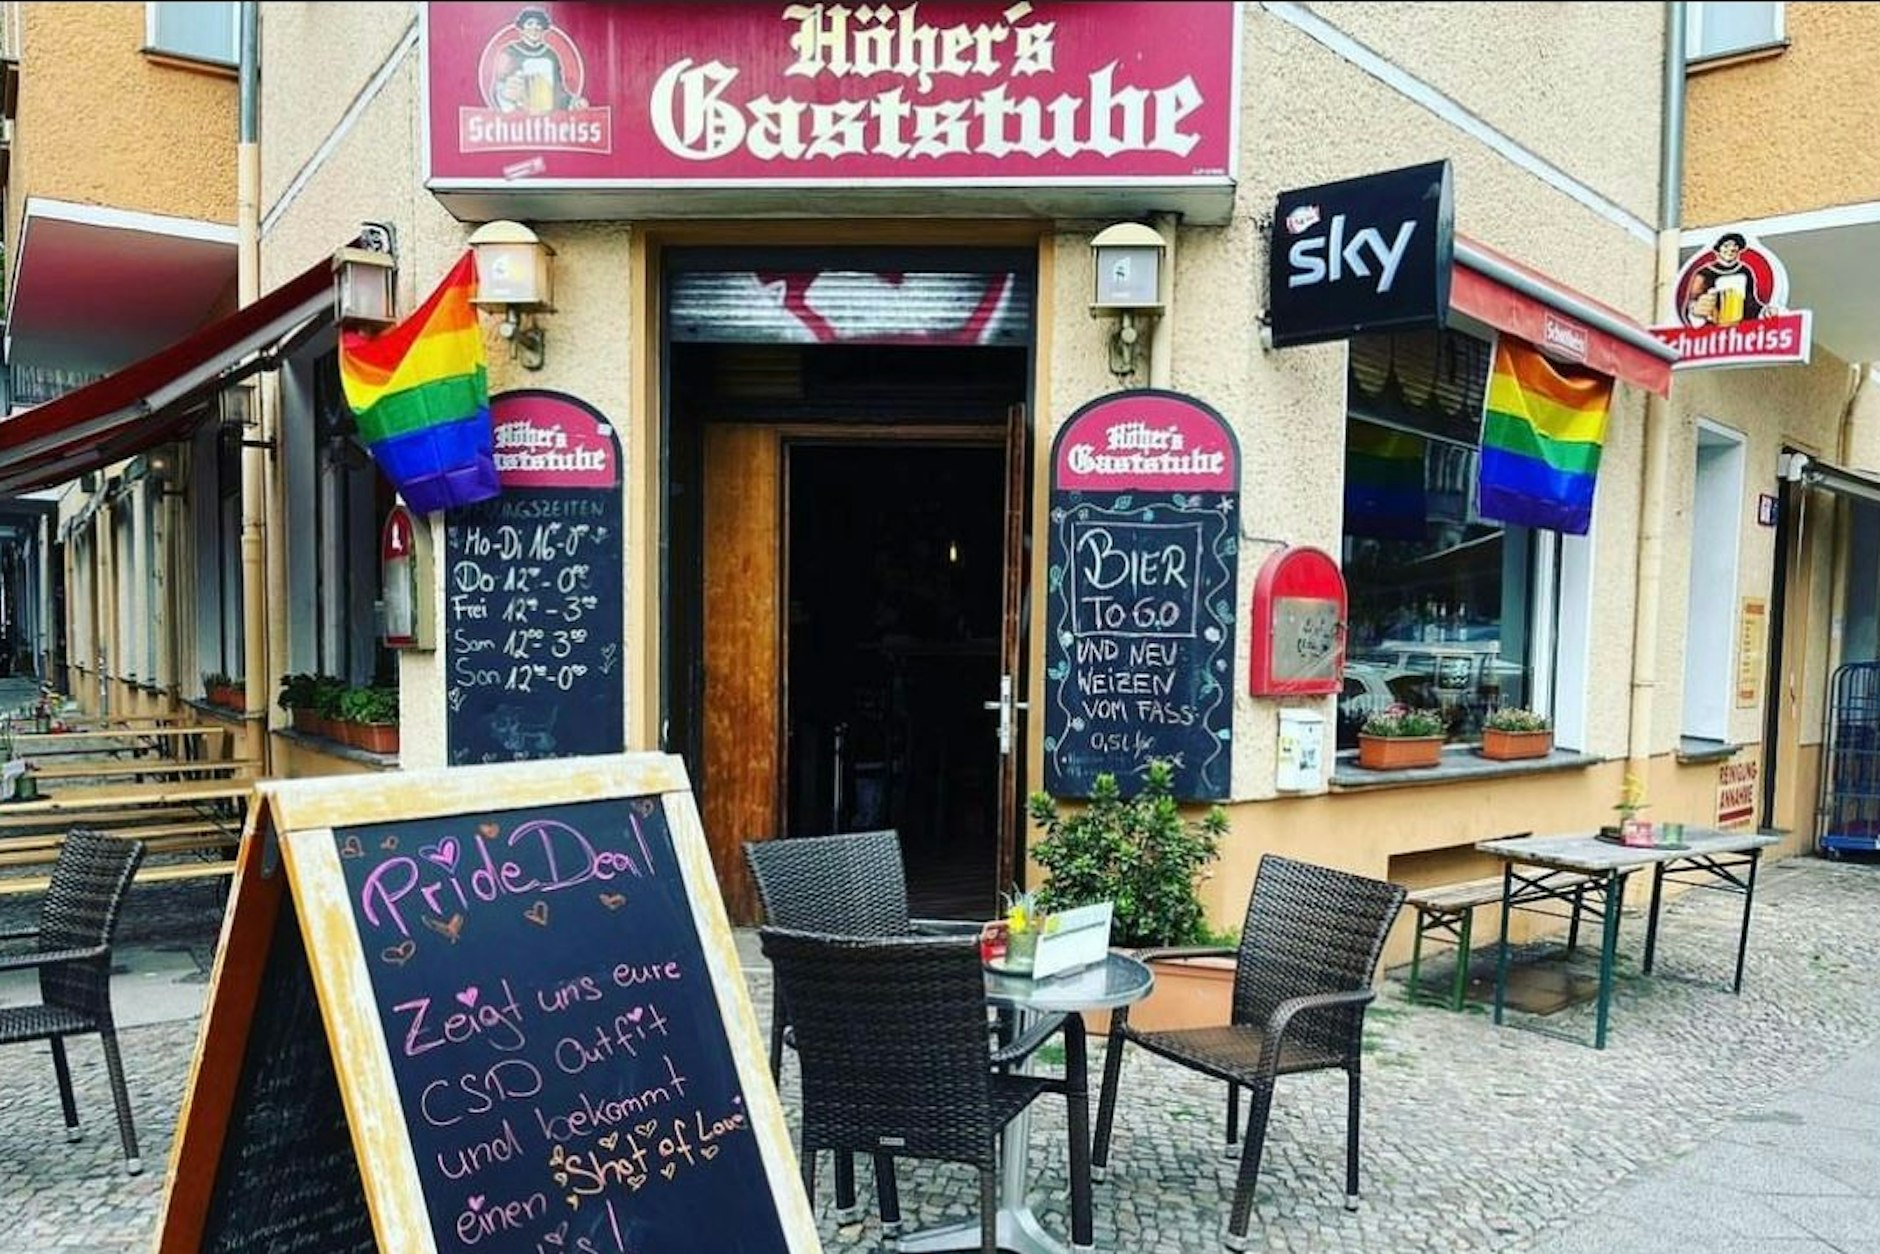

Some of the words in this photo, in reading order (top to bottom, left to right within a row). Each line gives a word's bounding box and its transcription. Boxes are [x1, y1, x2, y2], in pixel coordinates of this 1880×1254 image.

[469, 114, 602, 143] Schultheiss
[650, 57, 1203, 161] Gaststube
[1288, 215, 1418, 293] sky
[1067, 443, 1225, 475] Gaststube
[453, 560, 495, 593] Do
[1076, 527, 1188, 598] BIER
[450, 594, 488, 621] Frei
[1077, 637, 1119, 664] UND
[1081, 698, 1129, 723] VOM
[361, 833, 540, 938] Pride
[507, 812, 656, 892] Deal
[393, 979, 526, 1058] Zeigt
[537, 975, 603, 1015] uns
[612, 959, 683, 988] eure
[420, 1059, 543, 1127] CSD
[554, 1003, 670, 1075] Outfit
[436, 1117, 525, 1180] und
[534, 1054, 688, 1143] bekommt
[456, 1190, 548, 1245] einen
[564, 1132, 649, 1195] Shot
[658, 1118, 697, 1167] of
